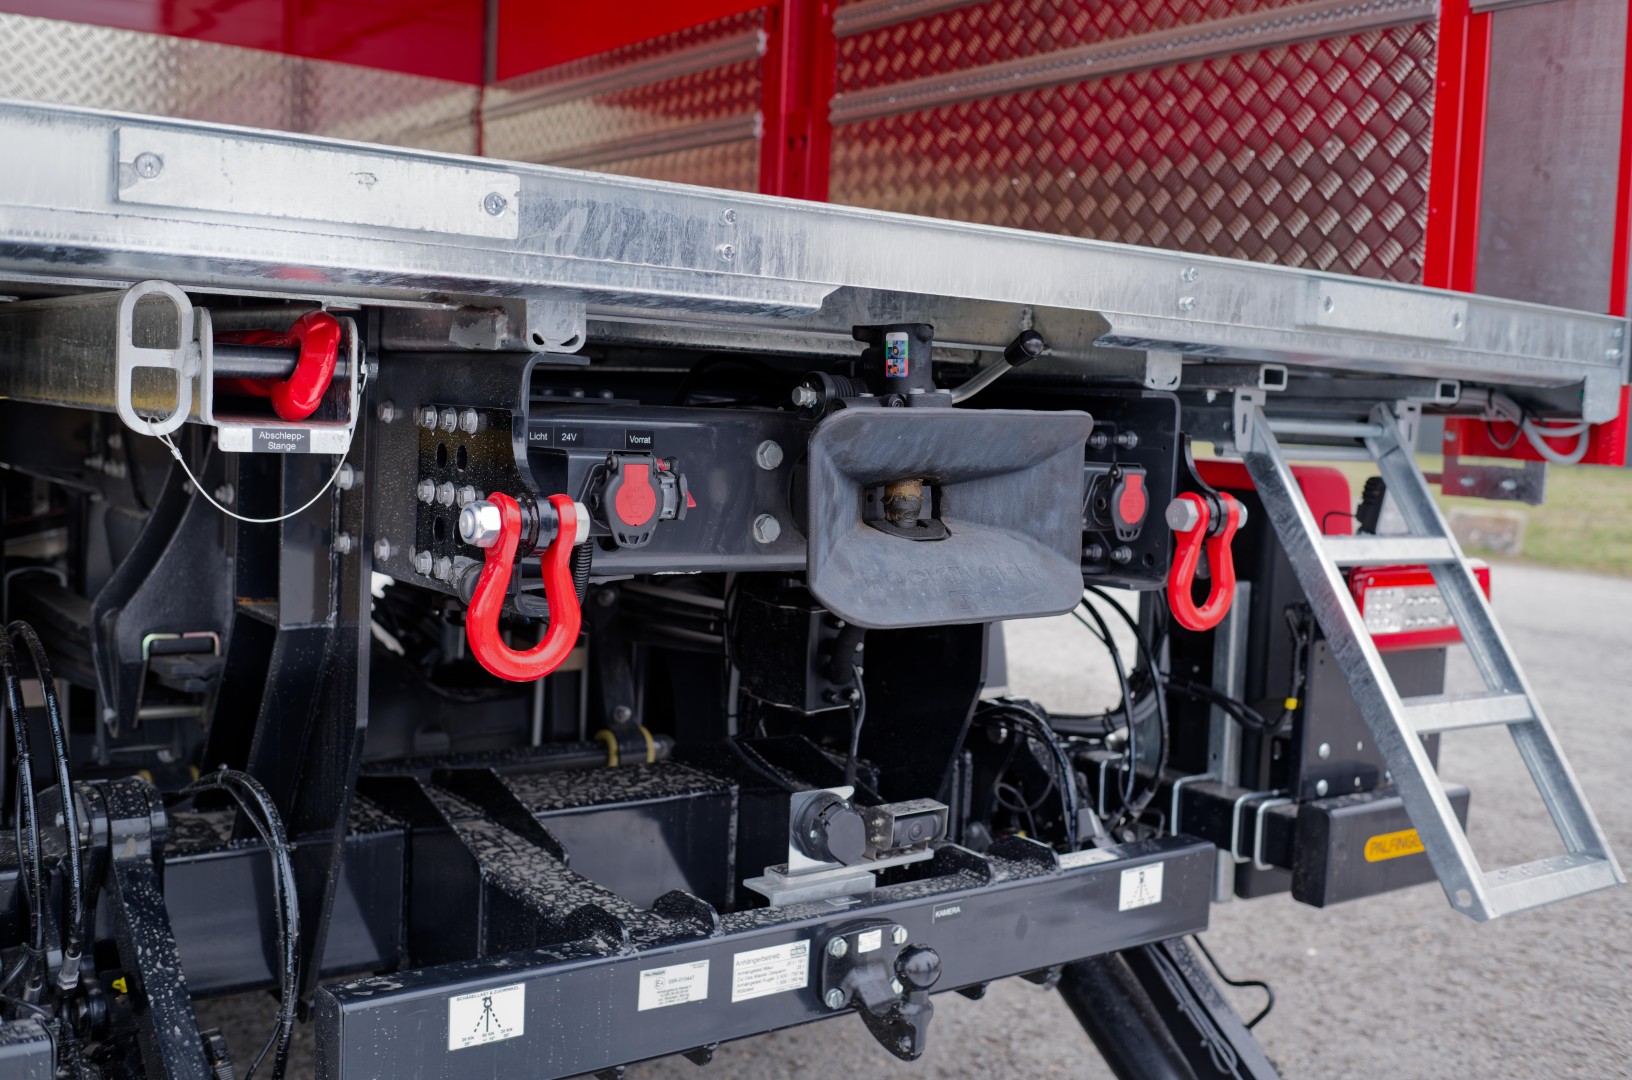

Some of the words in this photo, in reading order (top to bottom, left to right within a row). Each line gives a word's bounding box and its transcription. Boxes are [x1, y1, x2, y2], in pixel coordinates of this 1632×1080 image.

[259, 431, 304, 442] Abschlepp-
[529, 432, 548, 441] Licht
[561, 433, 578, 442] 24V
[629, 435, 651, 444] Vorrat
[267, 442, 296, 451] Stange
[935, 906, 961, 918] KAMERA
